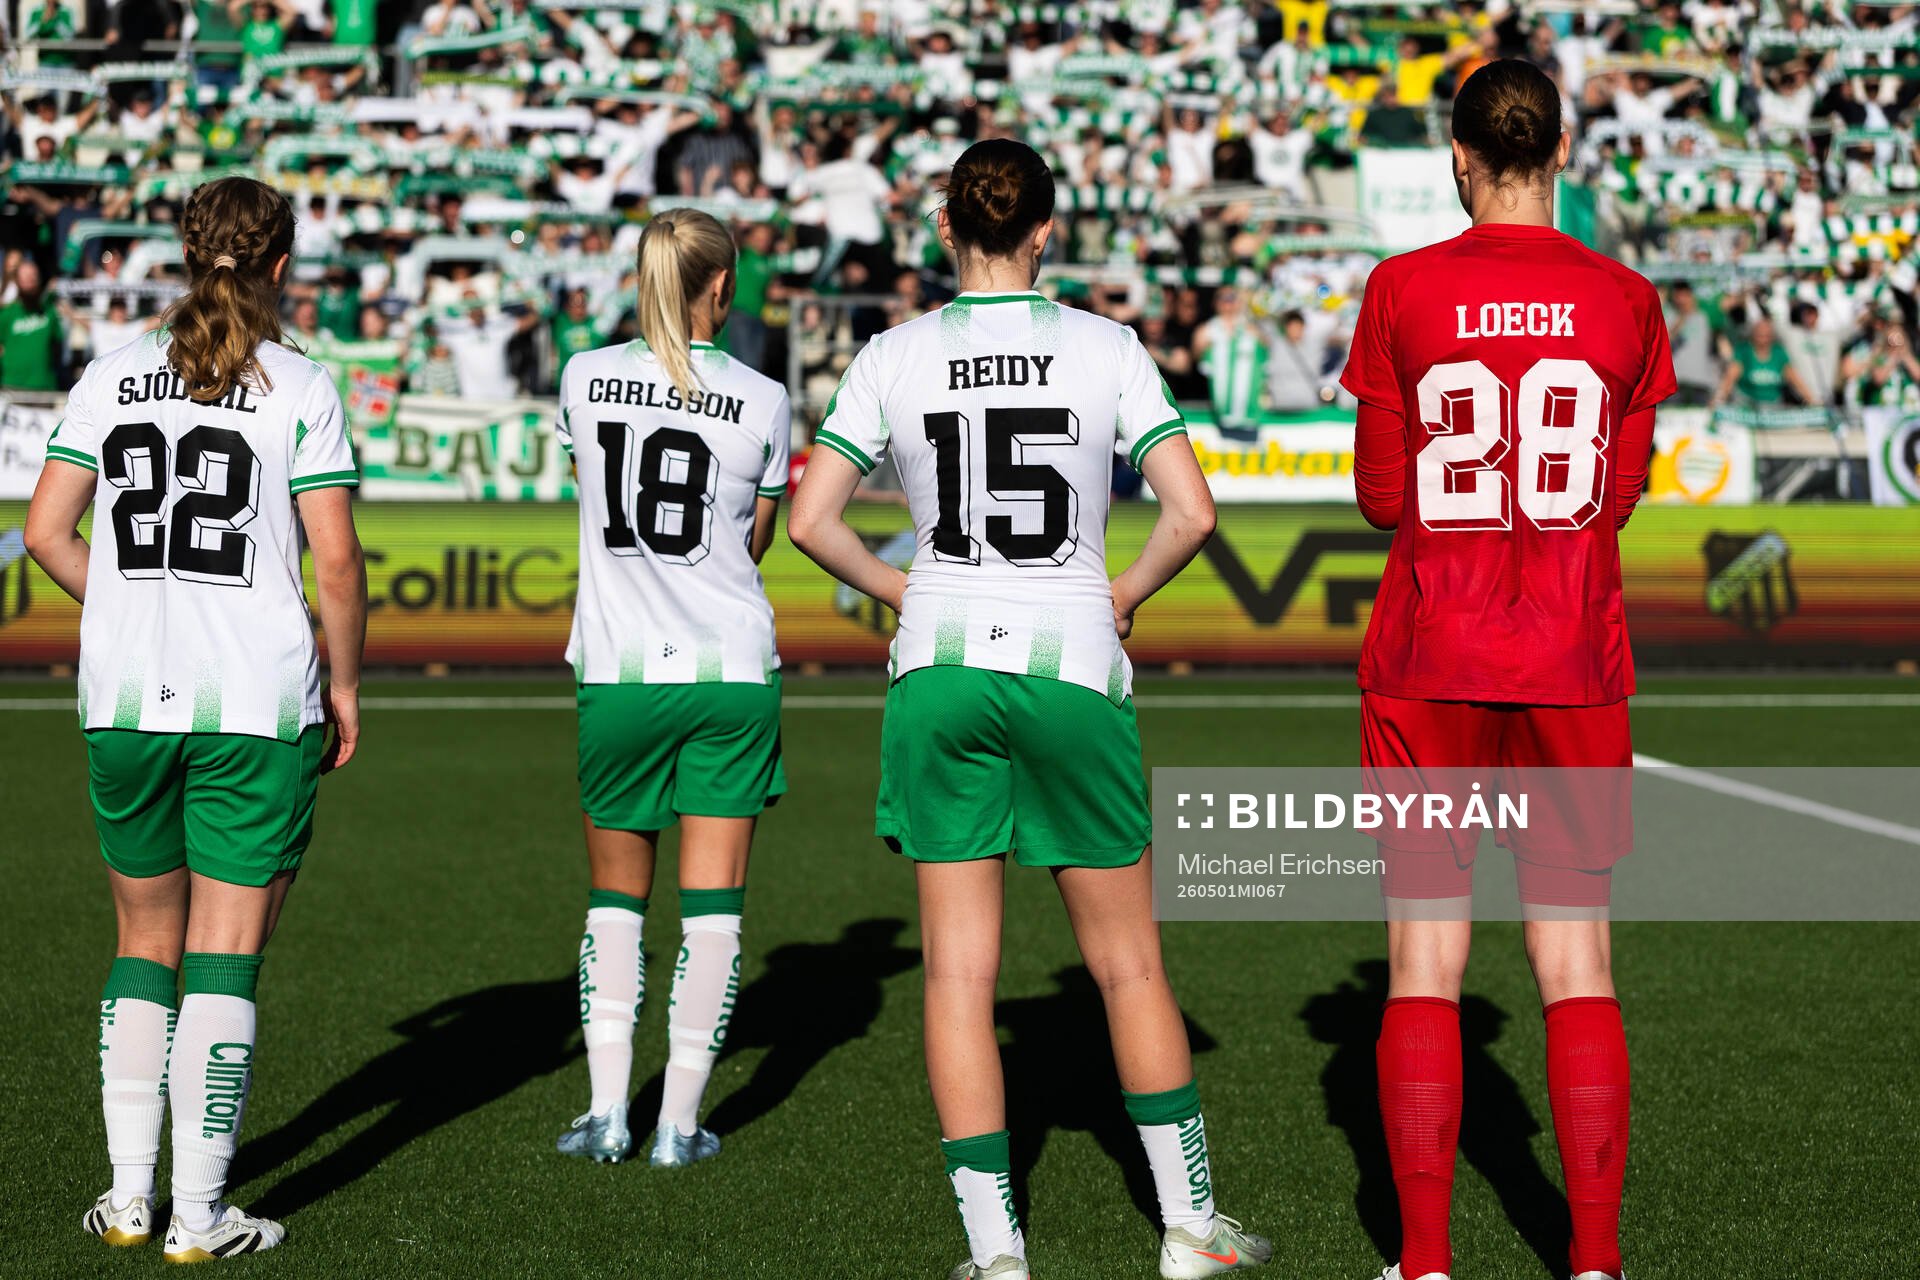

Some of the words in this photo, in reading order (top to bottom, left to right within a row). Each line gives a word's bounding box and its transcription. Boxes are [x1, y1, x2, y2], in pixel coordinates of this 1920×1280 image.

[948, 355, 1054, 390] REIDY
[1456, 302, 1575, 339] LOECK
[588, 378, 745, 424] CARLSSON
[1416, 358, 1611, 532] 28
[102, 422, 262, 588] 22
[597, 421, 720, 566] 18
[923, 408, 1080, 567] 15
